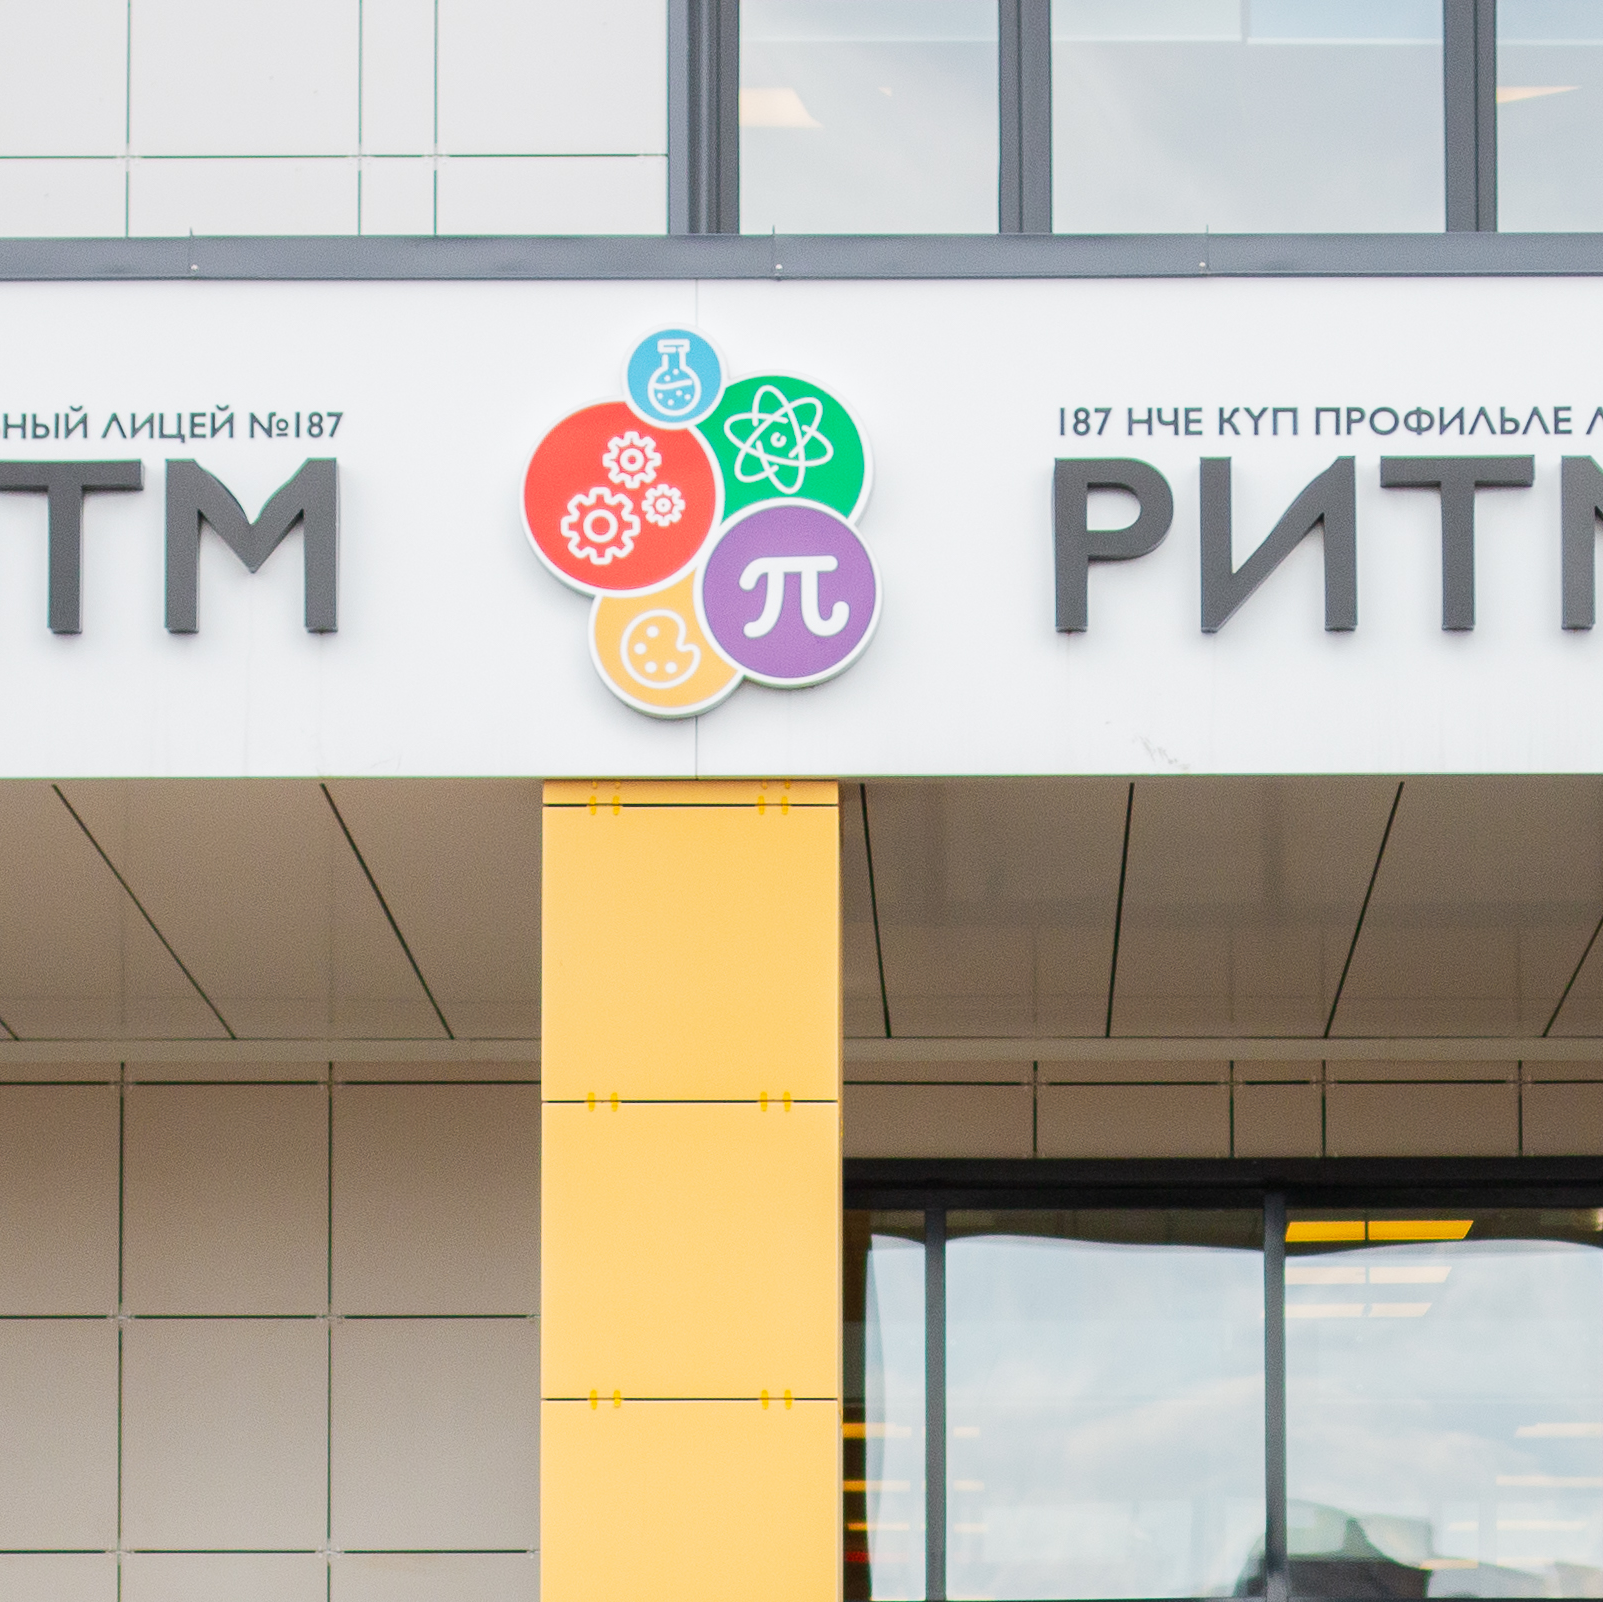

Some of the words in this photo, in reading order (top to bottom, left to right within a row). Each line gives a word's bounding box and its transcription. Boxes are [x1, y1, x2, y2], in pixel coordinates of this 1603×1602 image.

[101, 404, 236, 444] ЛИЦЕЙ
[248, 410, 344, 440] №187
[1058, 406, 1112, 437] 187
[1127, 407, 1203, 438] НЧЕ
[1314, 405, 1573, 437] ПРОФИЛЬЛЕ
